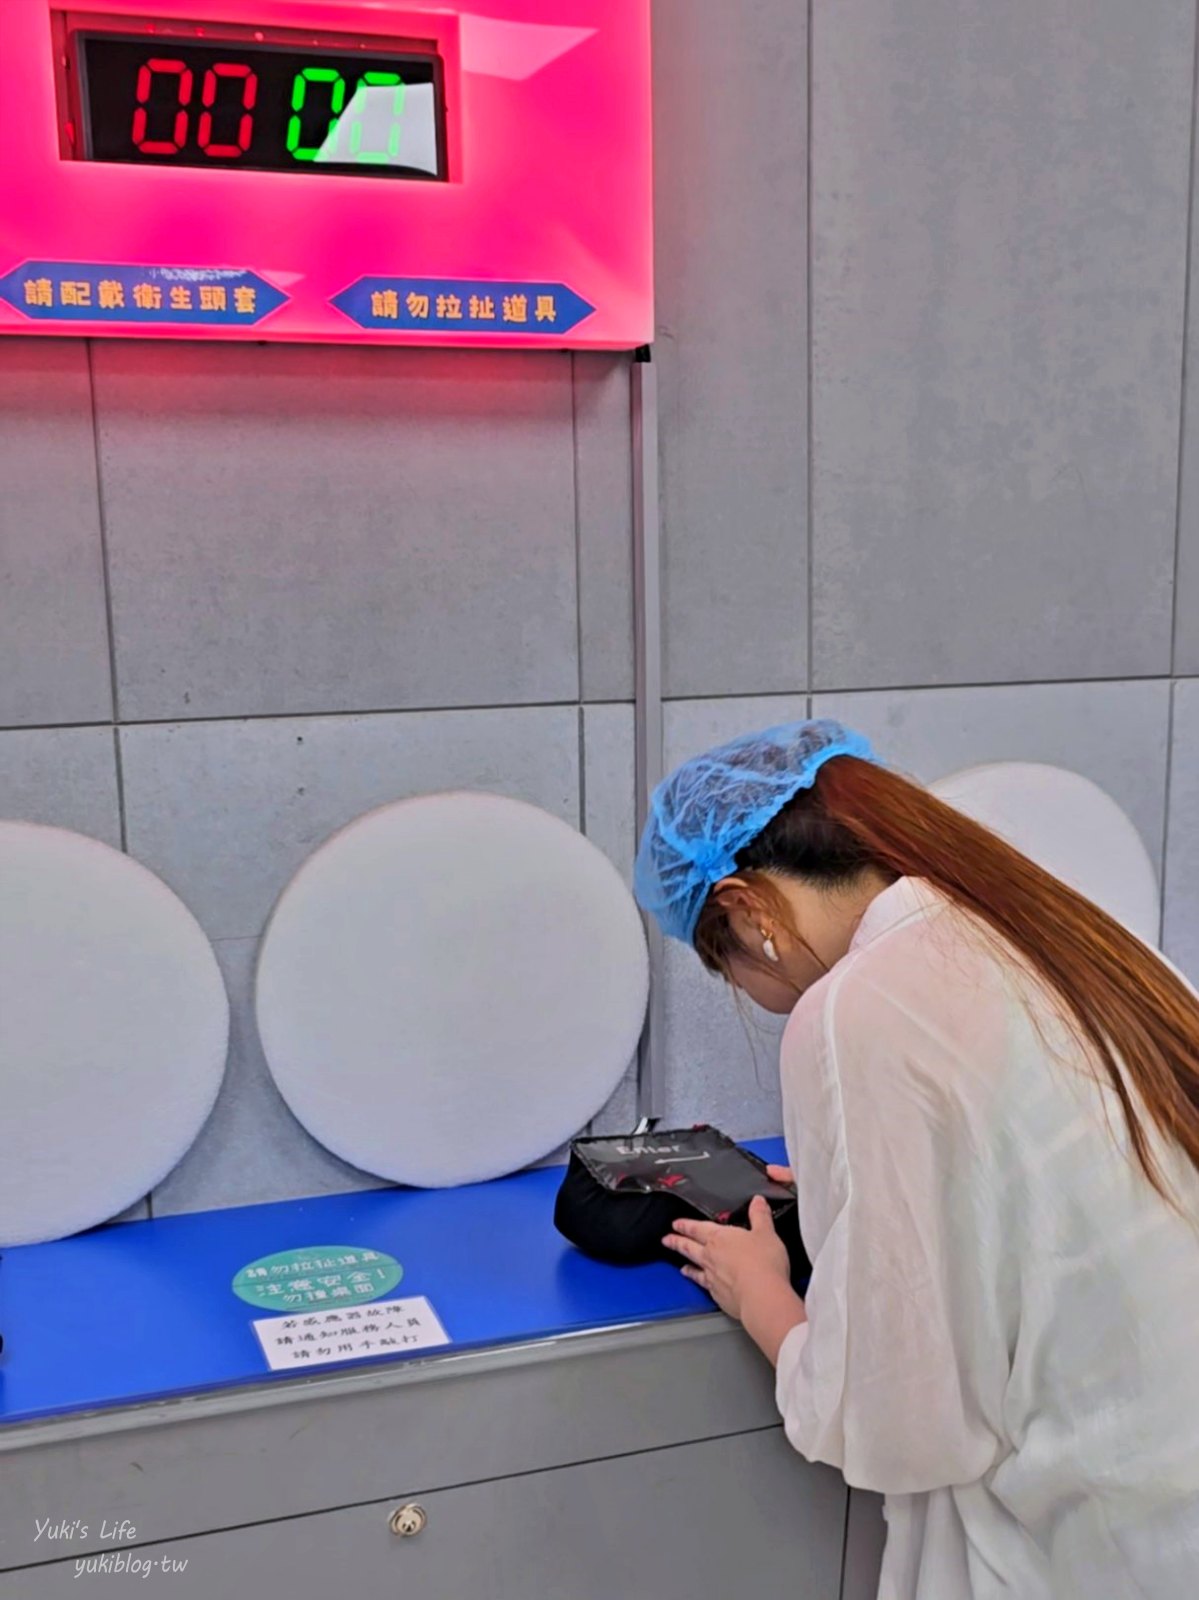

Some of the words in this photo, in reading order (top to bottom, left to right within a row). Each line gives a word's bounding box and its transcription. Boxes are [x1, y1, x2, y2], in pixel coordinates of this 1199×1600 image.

[132, 58, 257, 157] 00
[286, 67, 404, 163] 00
[23, 277, 256, 313] 請配戴衛生頭套
[370, 289, 556, 322] 請勿拉扯道具
[246, 1251, 379, 1278] 請勿拉扯道具
